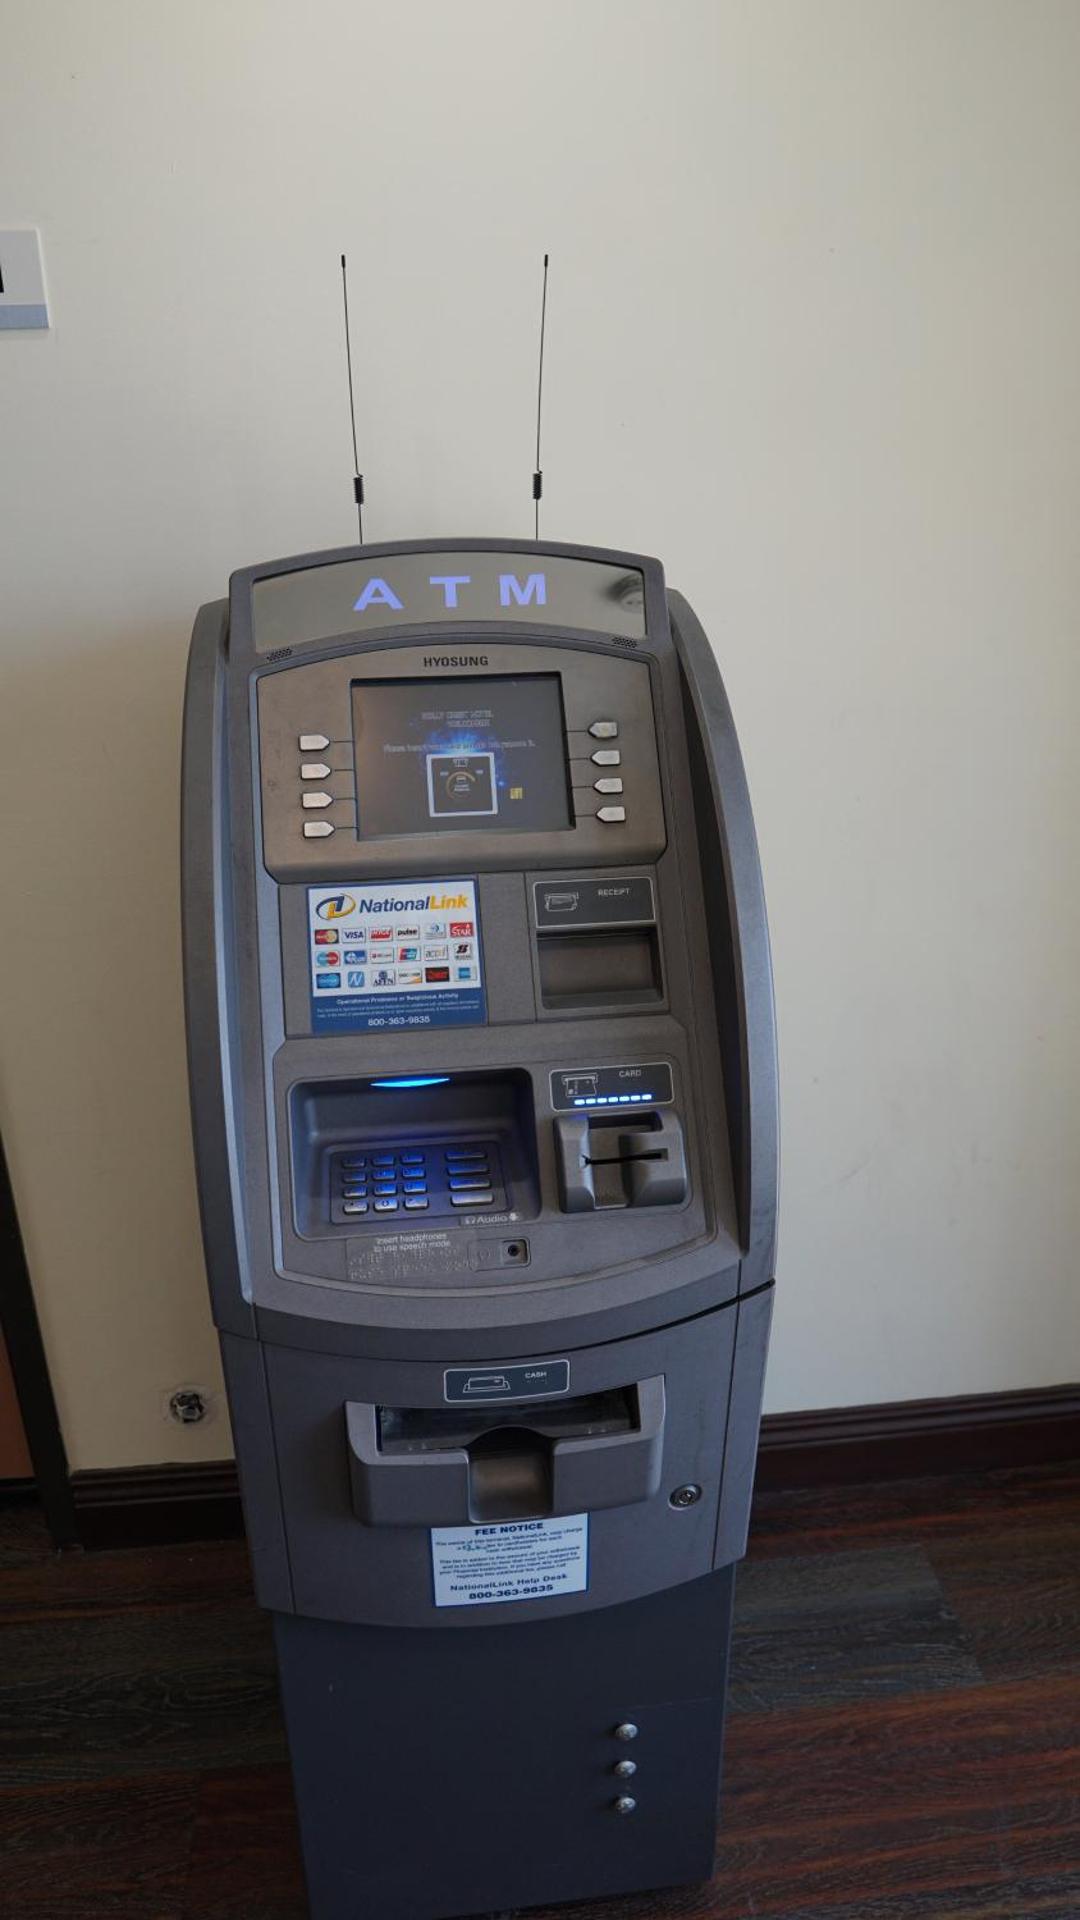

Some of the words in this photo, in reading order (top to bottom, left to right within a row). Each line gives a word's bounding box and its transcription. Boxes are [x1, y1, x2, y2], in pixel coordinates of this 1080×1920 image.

[353, 573, 547, 611] ATM
[423, 656, 489, 667] HYOSUNG
[359, 894, 469, 913] NationalLink
[397, 928, 418, 936] pulse
[367, 1015, 431, 1026] 800-363-9835
[477, 1214, 508, 1224] Audio
[475, 1527, 497, 1536] FEE
[500, 1522, 544, 1534] NOTICE
[450, 1579, 513, 1591] NationalLink
[517, 1577, 540, 1587] Help
[543, 1573, 567, 1582] Desk
